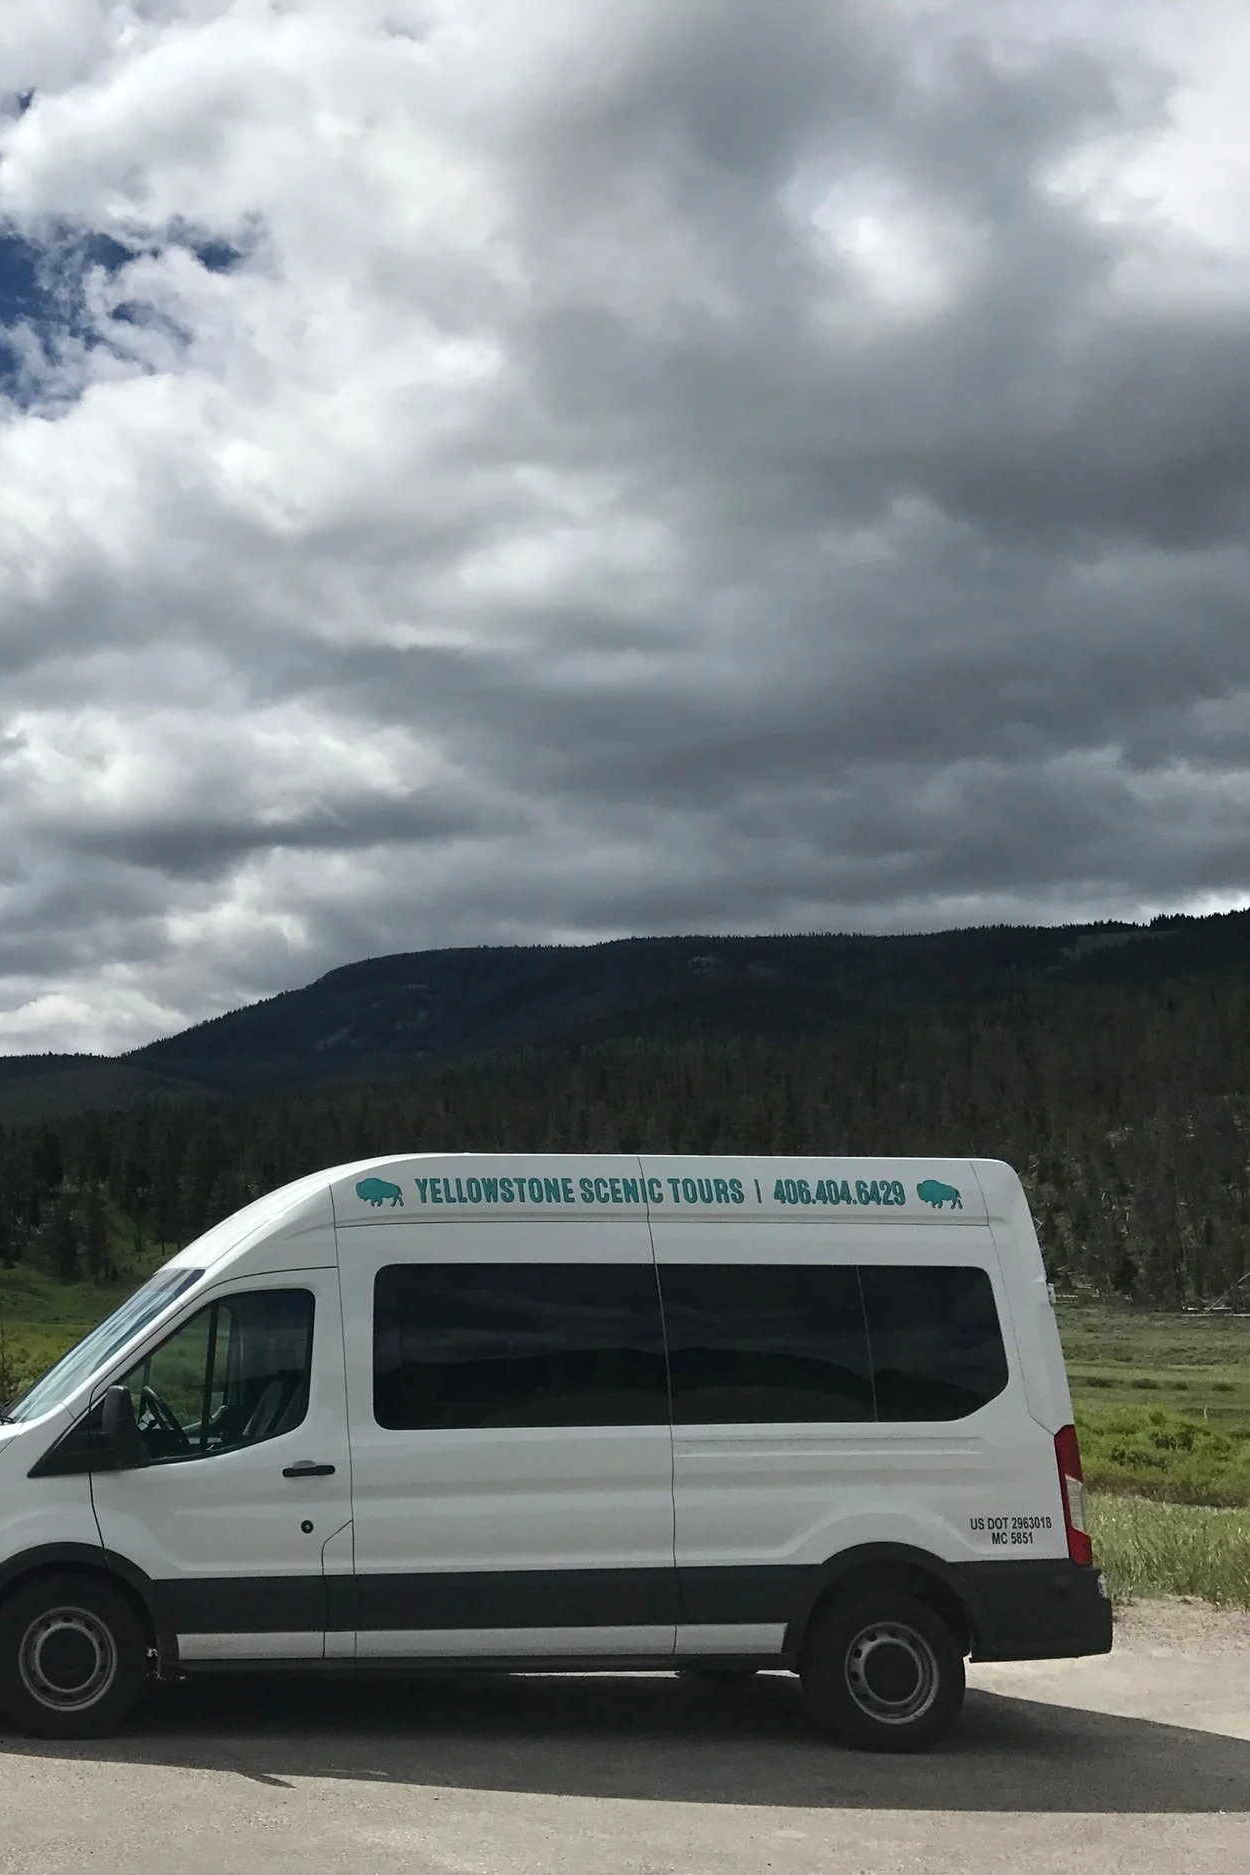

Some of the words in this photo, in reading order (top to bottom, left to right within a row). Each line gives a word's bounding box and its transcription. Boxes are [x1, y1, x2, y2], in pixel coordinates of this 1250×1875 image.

[414, 1178, 576, 1204] YELLOWSTONE
[579, 1178, 664, 1204] SCENIC
[667, 1178, 745, 1204] TOURS
[773, 1179, 906, 1206] 406.404.6429
[970, 1517, 985, 1531] US
[987, 1517, 1009, 1530] DOT
[1011, 1516, 1052, 1530] 2963018
[991, 1532, 1008, 1545] MC
[1010, 1532, 1034, 1545] 5851
